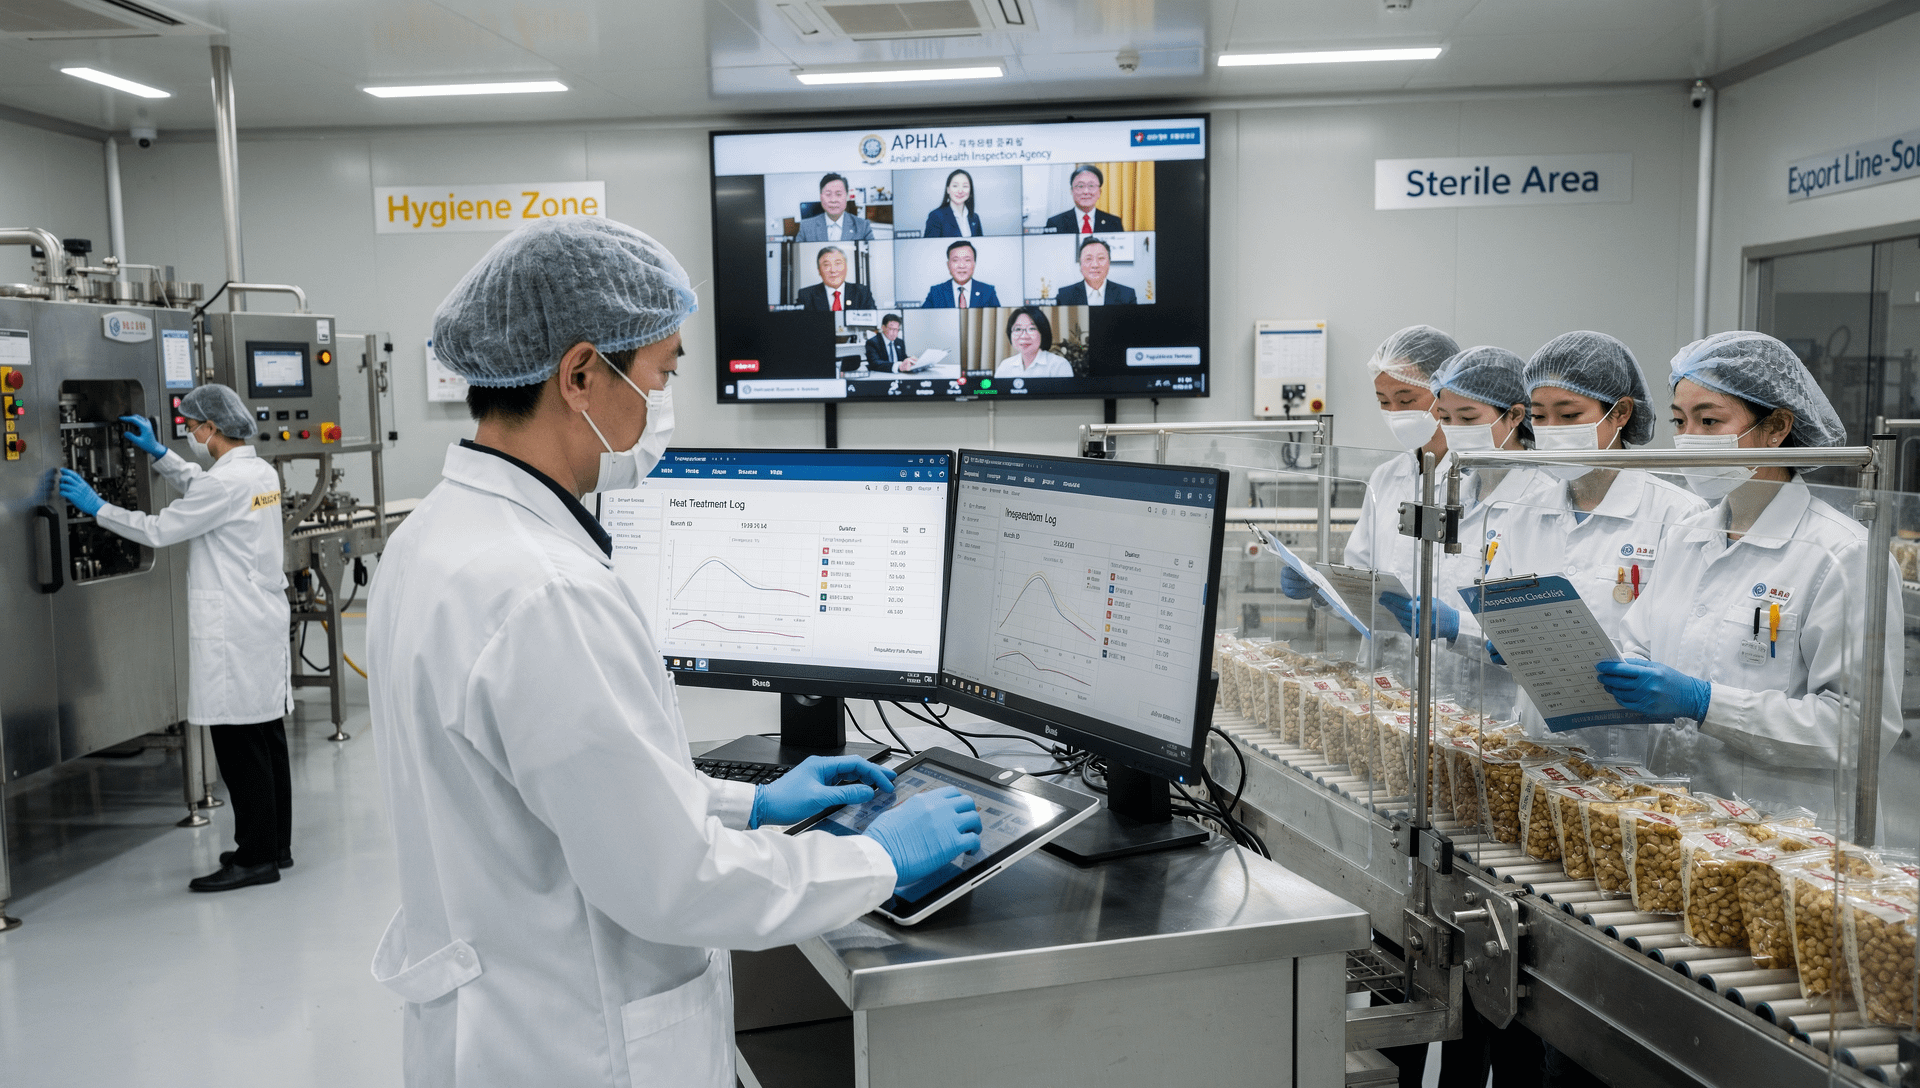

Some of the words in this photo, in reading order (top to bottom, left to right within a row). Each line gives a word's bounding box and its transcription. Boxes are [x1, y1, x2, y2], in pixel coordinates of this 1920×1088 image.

[891, 133, 948, 151] APHIA
[921, 152, 939, 163] and
[941, 151, 970, 162] Health
[971, 148, 1018, 162] Inspection
[1020, 149, 1052, 161] Agency
[1406, 165, 1512, 198] Sterile
[1521, 165, 1600, 194] Area
[1788, 157, 1841, 198] Export
[387, 192, 512, 229] Hygiene
[521, 191, 599, 219] Zone
[669, 498, 687, 508] Heat
[689, 498, 727, 509] Treatment
[729, 499, 746, 511] Log
[1044, 512, 1057, 527] Log
[1484, 595, 1525, 607] nspection
